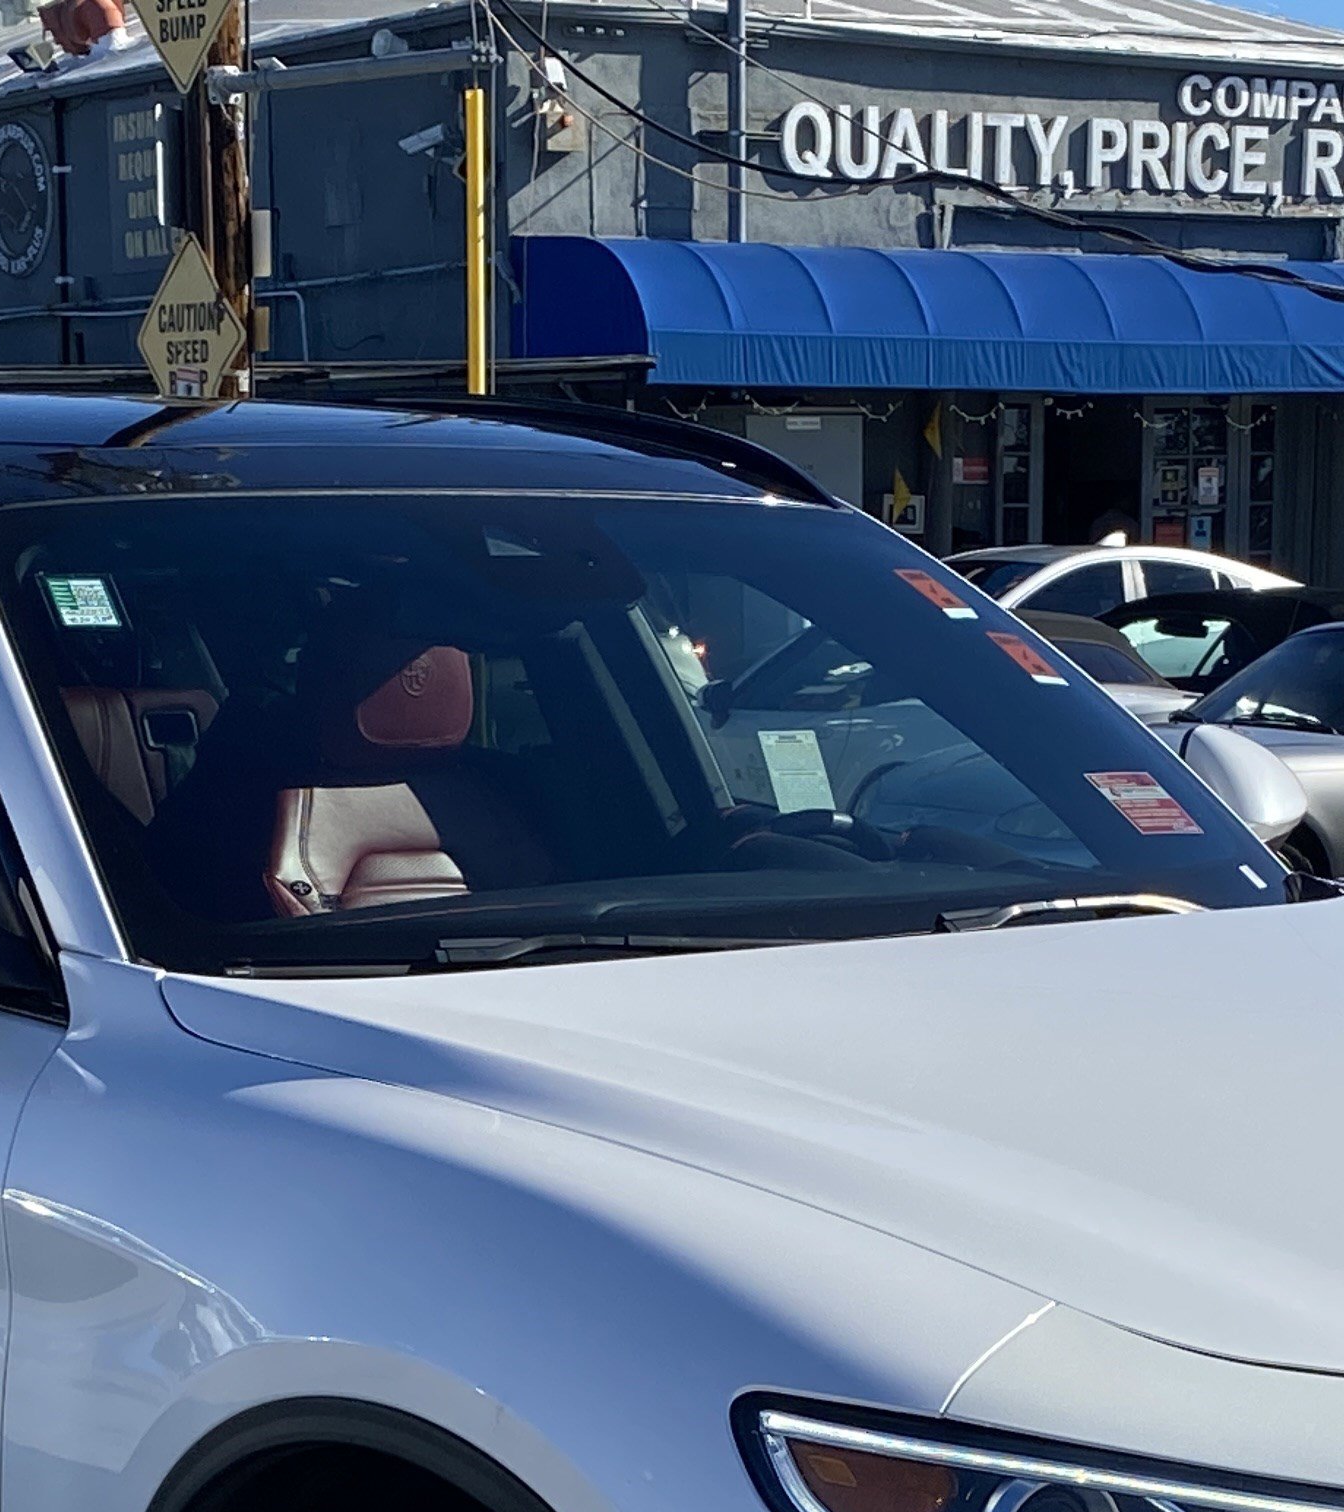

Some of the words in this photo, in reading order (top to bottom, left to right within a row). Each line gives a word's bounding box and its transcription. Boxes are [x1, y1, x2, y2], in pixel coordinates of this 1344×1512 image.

[160, 14, 206, 43] BUMP
[780, 100, 1077, 198] QUALITY,
[1087, 116, 1283, 215] PRICE,
[167, 339, 209, 365] SPEED
[169, 369, 208, 396] BP
